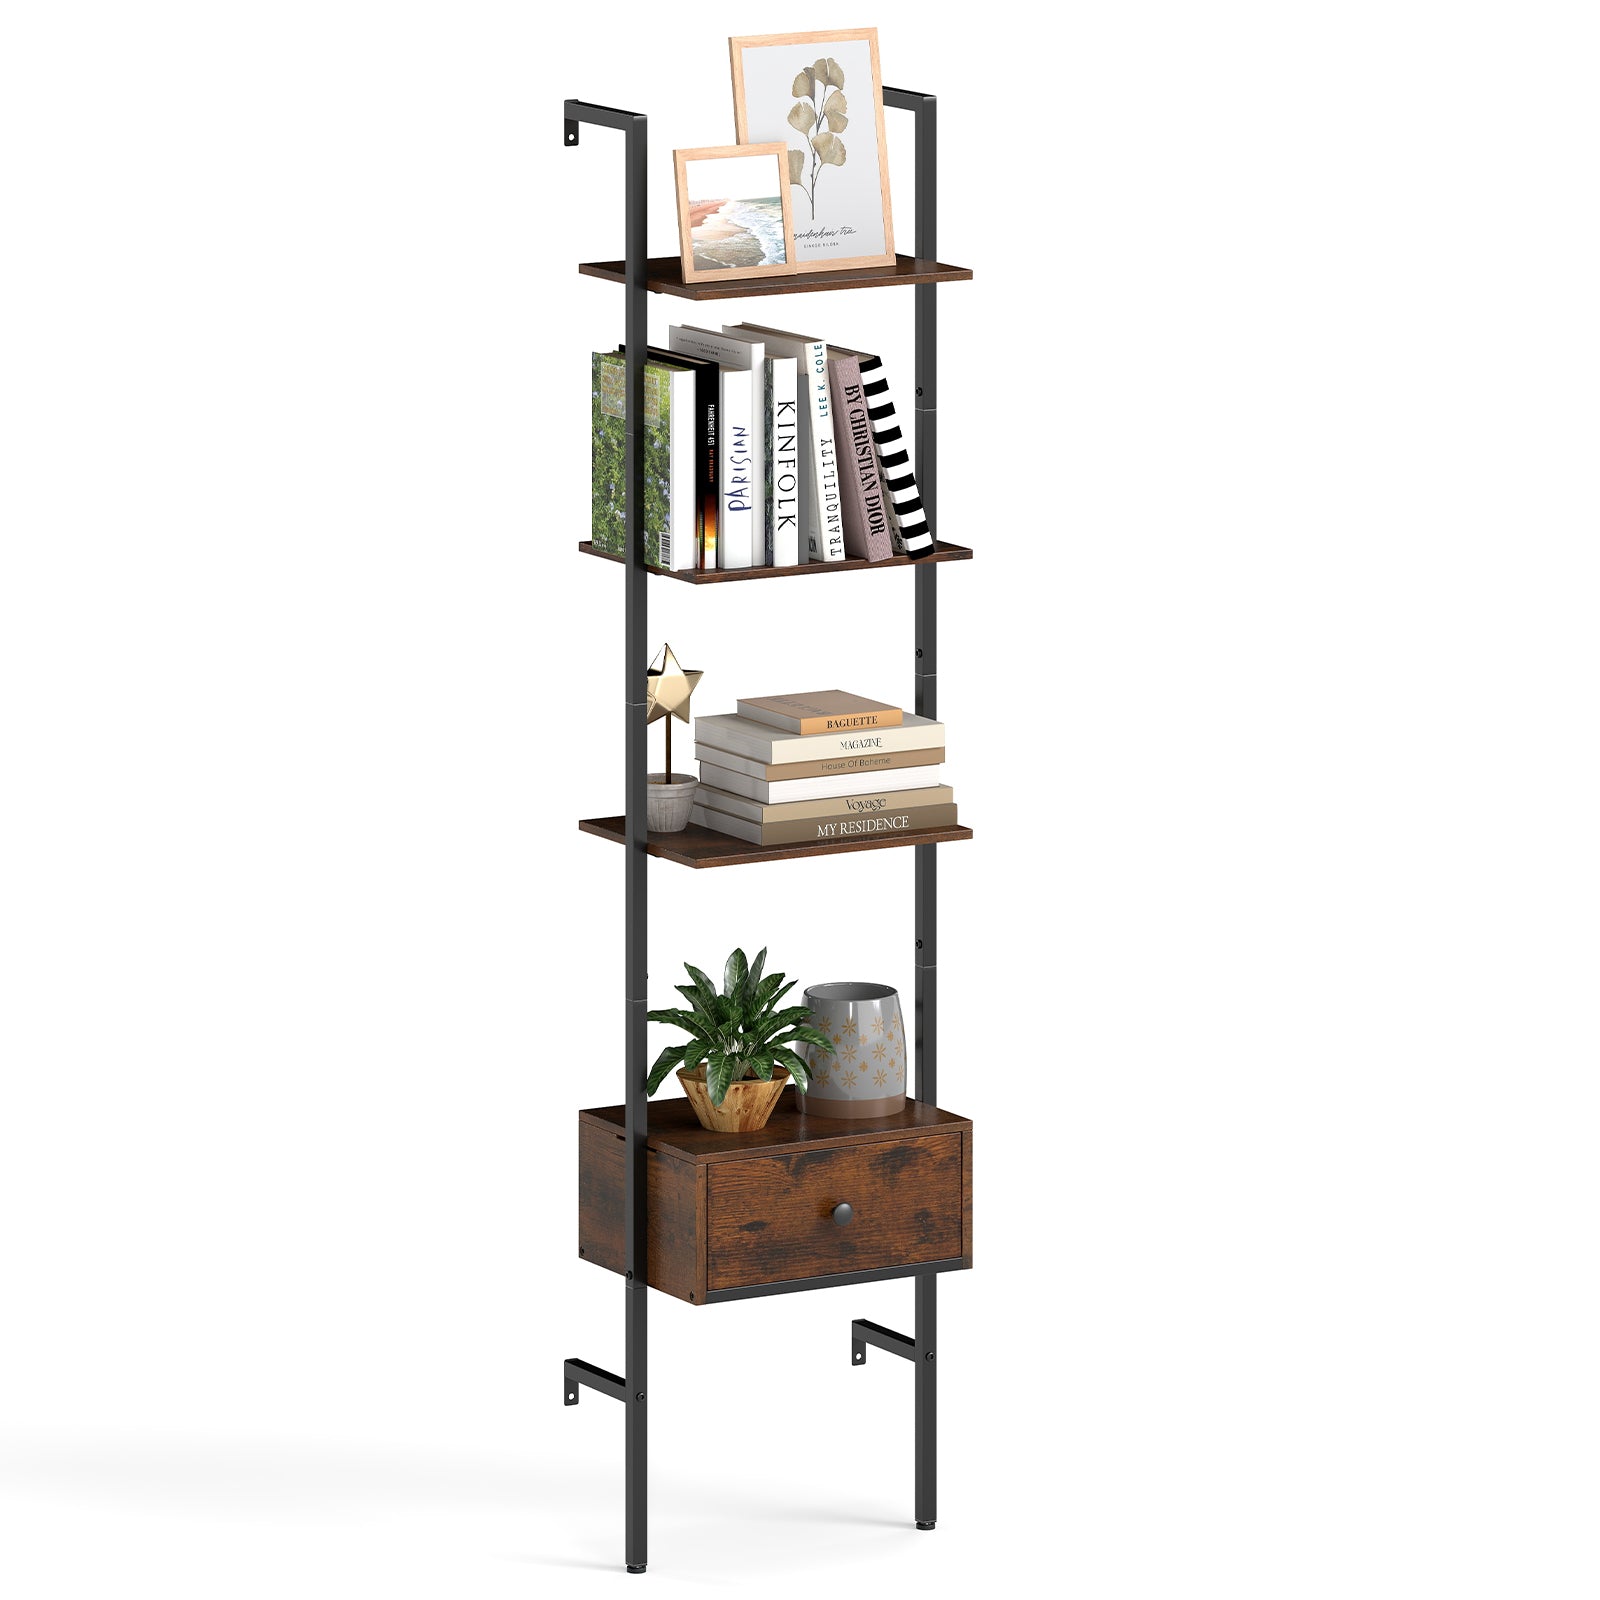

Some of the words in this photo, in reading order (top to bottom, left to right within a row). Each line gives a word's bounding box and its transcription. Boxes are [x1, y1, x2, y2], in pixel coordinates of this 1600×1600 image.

[814, 344, 825, 374] COLE
[817, 379, 826, 391] K.
[844, 384, 863, 404] BY
[819, 397, 828, 417] LEE
[707, 404, 715, 435] FAHRENHEIT
[707, 437, 715, 446] 451
[849, 408, 879, 492] CHRISTIAN
[724, 426, 752, 512] PARISIAN
[777, 400, 796, 532] KINFOLK
[820, 438, 842, 557] TRANQUILITY
[865, 493, 885, 537] DIOR
[826, 715, 879, 729] BAGUETTE
[840, 737, 883, 751] MAGAZINE
[821, 760, 846, 771] House
[847, 758, 859, 768] Of
[859, 756, 892, 767] Boheme
[845, 797, 887, 813] Voyage
[816, 824, 838, 838] MY
[840, 815, 910, 835] RESIDENCE
